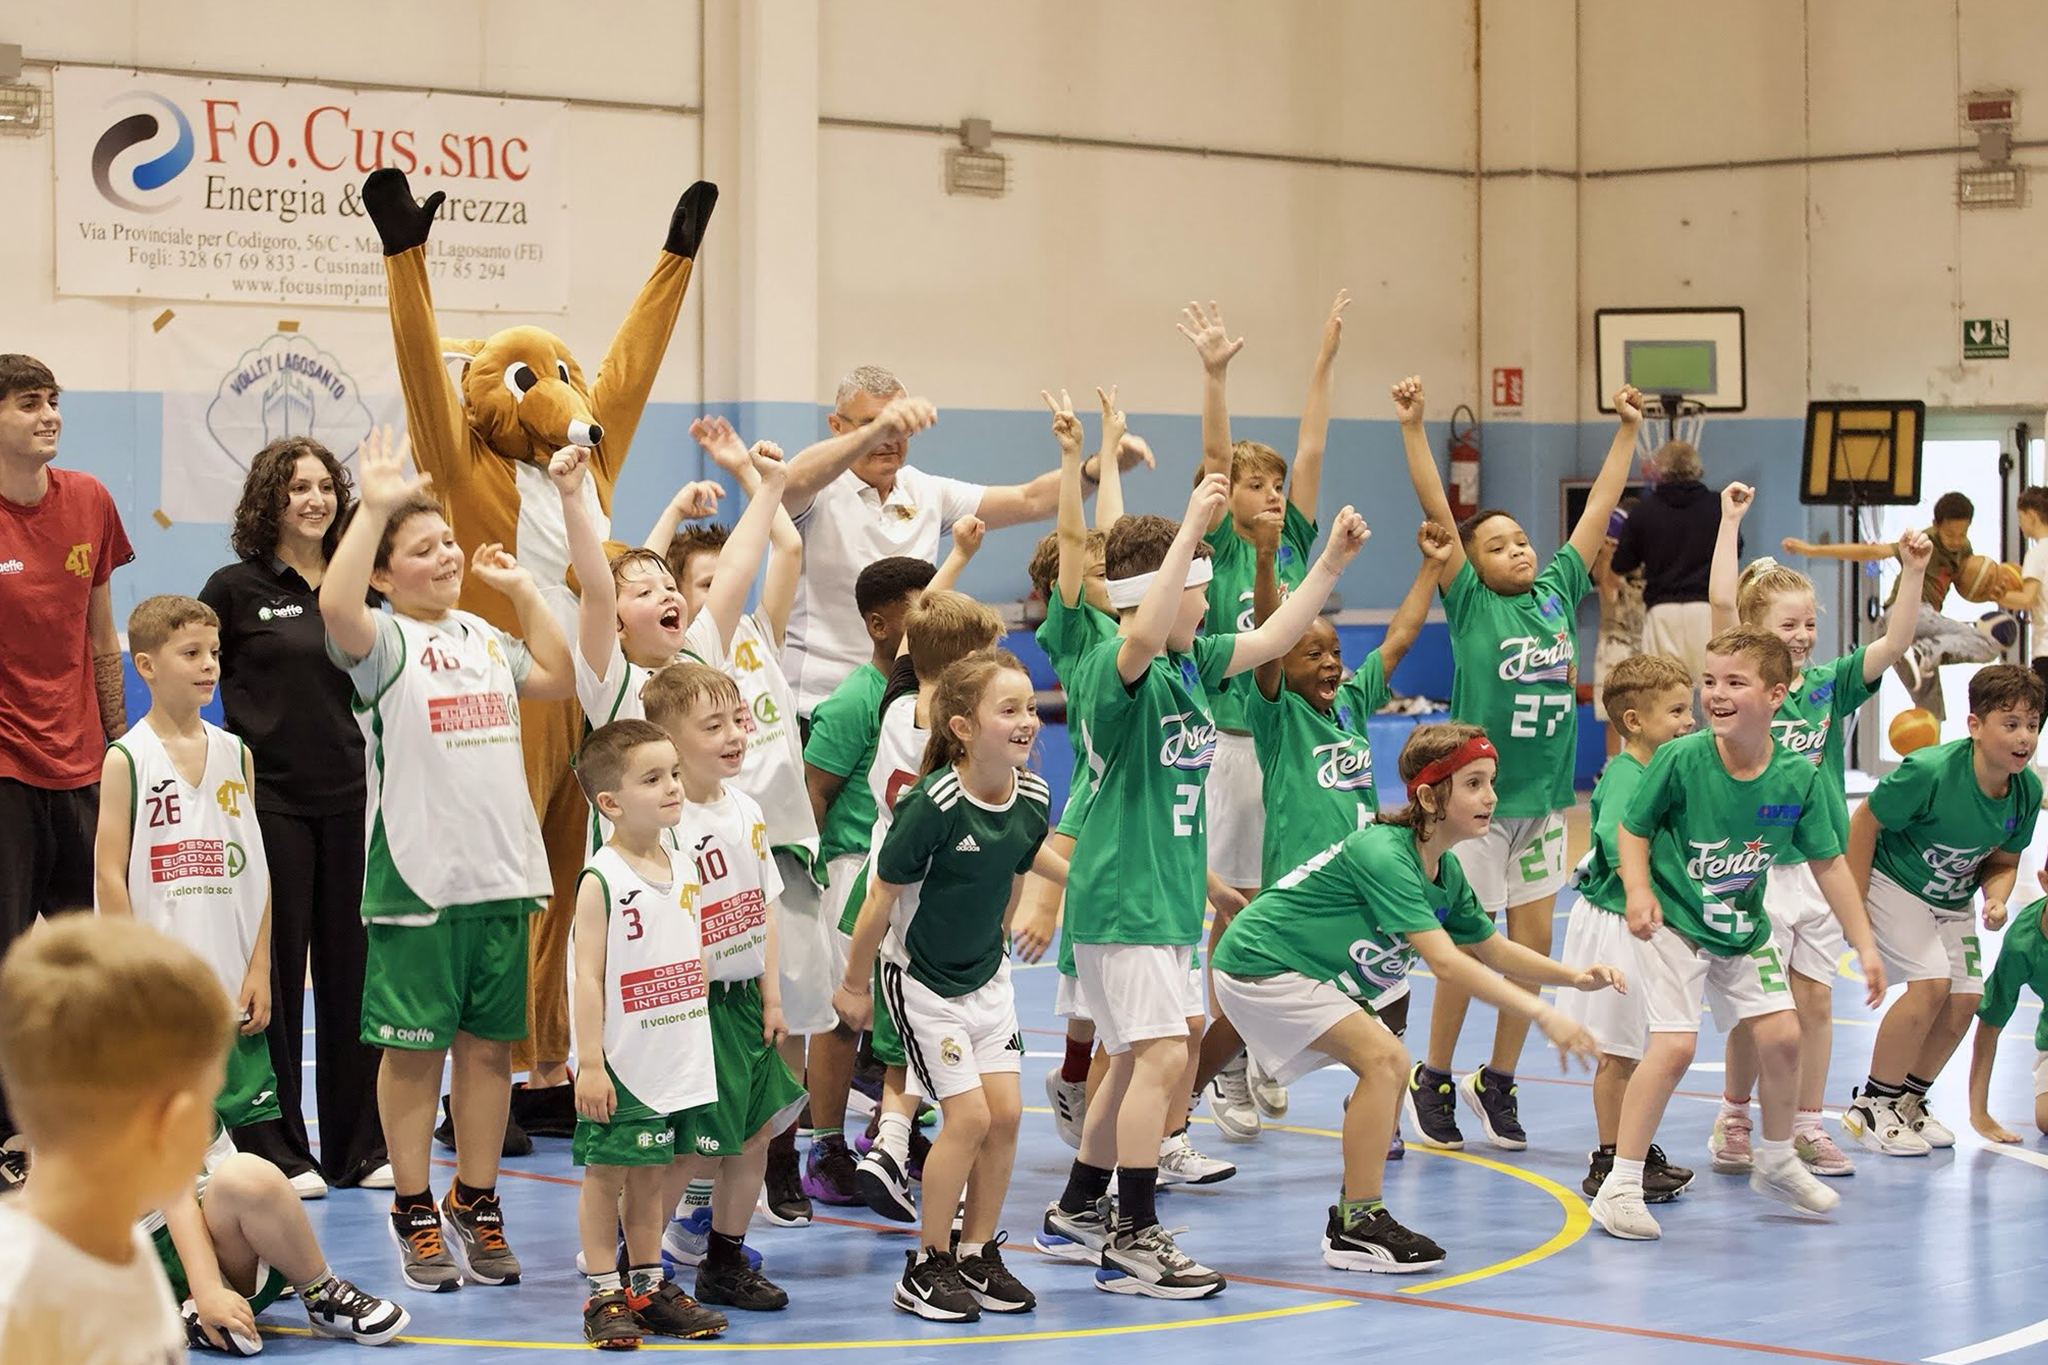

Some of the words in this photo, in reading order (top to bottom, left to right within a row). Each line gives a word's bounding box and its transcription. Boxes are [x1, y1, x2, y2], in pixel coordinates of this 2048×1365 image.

[201, 99, 530, 181] Fo.Cus.snc
[204, 175, 327, 223] Energia
[338, 182, 366, 217] &
[79, 222, 107, 241] Via
[112, 223, 193, 246] Provinciale
[197, 232, 223, 249] per
[306, 233, 340, 252] 56/C
[438, 241, 512, 262] Lagosanto
[514, 243, 544, 262] (FE)
[128, 246, 173, 269] Fogli:
[178, 250, 208, 268] 328
[212, 251, 233, 269] 67
[239, 252, 259, 271] 69
[265, 254, 296, 272] 833
[313, 256, 385, 277] Cusinatti
[431, 260, 447, 279] 77
[452, 261, 472, 279] 85
[479, 262, 506, 280] 294
[232, 276, 388, 300] www.focusimpianti
[230, 356, 273, 396] VOLLEY
[276, 352, 346, 400] LAGOSANTO
[273, 604, 303, 617] aeffe
[1511, 693, 1572, 738] 27
[145, 793, 182, 828] 26
[696, 847, 728, 886] 10
[622, 907, 644, 941] 3
[723, 940, 754, 957] valore
[1961, 936, 1983, 977] 2
[654, 960, 702, 978] DESPA
[1750, 947, 1787, 993] 2
[641, 1019, 648, 1030] Il
[650, 1013, 687, 1028] valore
[688, 1006, 707, 1020] del
[397, 1028, 435, 1043] aeffe
